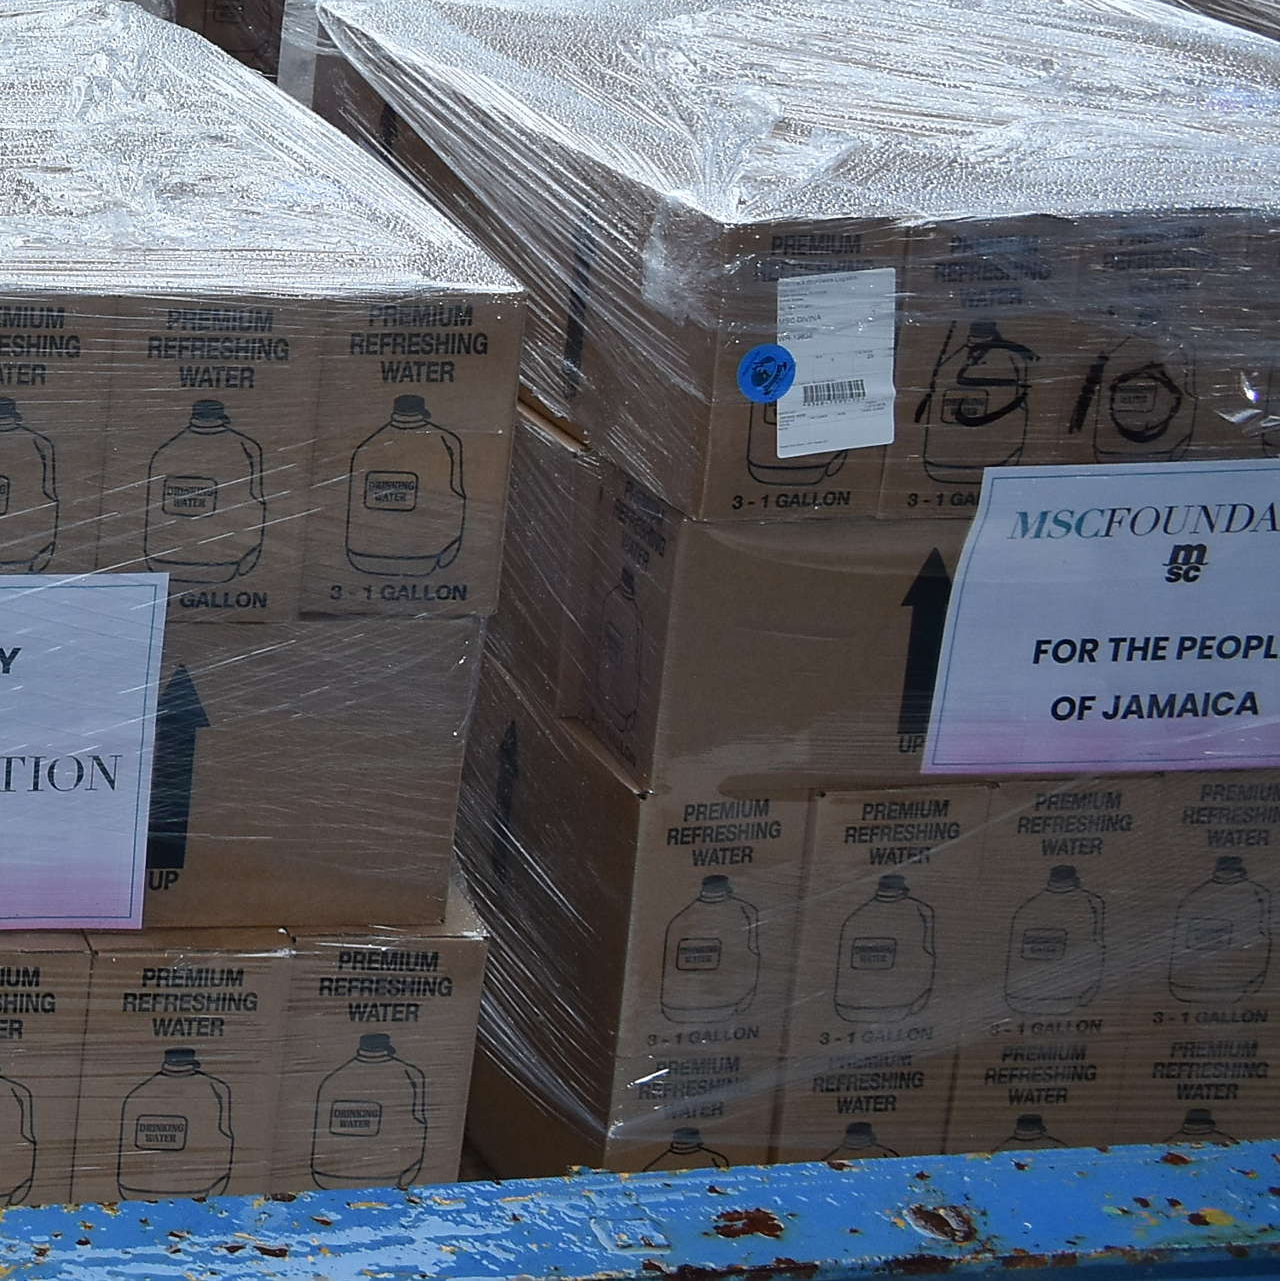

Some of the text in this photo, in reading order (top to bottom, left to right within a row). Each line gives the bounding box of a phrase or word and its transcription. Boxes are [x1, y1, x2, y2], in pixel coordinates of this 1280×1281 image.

[166, 308, 274, 332] PREMIUM
[367, 303, 474, 328] PREMIUM
[146, 336, 289, 361] REFRESHING
[349, 331, 489, 356] REFRESHING
[178, 365, 256, 389] WATER
[380, 359, 456, 383] WATER
[775, 489, 851, 511] GALLON
[1008, 501, 1280, 543] MSCFOUNDA
[178, 591, 268, 610] GALLON
[379, 582, 468, 601] GALLON
[1032, 633, 1280, 665] FOR THE PEOPL
[1050, 690, 1259, 721] OF JAMAICA
[898, 733, 927, 754] UP
[683, 798, 770, 823] PREMIUM
[861, 799, 949, 823] PREMIUM
[1034, 791, 1123, 814] PREMIUM
[666, 820, 782, 847] REFRESHING
[844, 819, 961, 845] REFRESHING
[1016, 811, 1133, 835] REFRESHING
[1040, 835, 1103, 857] WATER
[1207, 826, 1270, 849] WATER
[691, 845, 754, 868] WATER
[868, 845, 932, 867] WATER
[148, 869, 180, 892] UP
[338, 950, 440, 973] PREMIUM
[141, 967, 245, 990] PREMIUM
[318, 975, 454, 998] REFRESHING
[122, 991, 259, 1015] REFRESHING
[347, 1001, 421, 1023] WATER
[151, 1017, 226, 1039] WATER
[1194, 1009, 1269, 1025] GALLON
[1000, 1043, 1087, 1064] PREMIUM
[1169, 1039, 1259, 1062] PREMIUM
[812, 1070, 925, 1093] REFRESHING
[984, 1062, 1098, 1086] REFRESHING
[1151, 1061, 1269, 1083] REFRESHING
[1007, 1085, 1069, 1107] WATER
[1176, 1081, 1240, 1102] WATER
[332, 1107, 379, 1122] DRINKING
[836, 1094, 897, 1115] WATER
[138, 1121, 186, 1137] DRINKING
[338, 1117, 371, 1130] WATER
[144, 1132, 178, 1145] WATER
